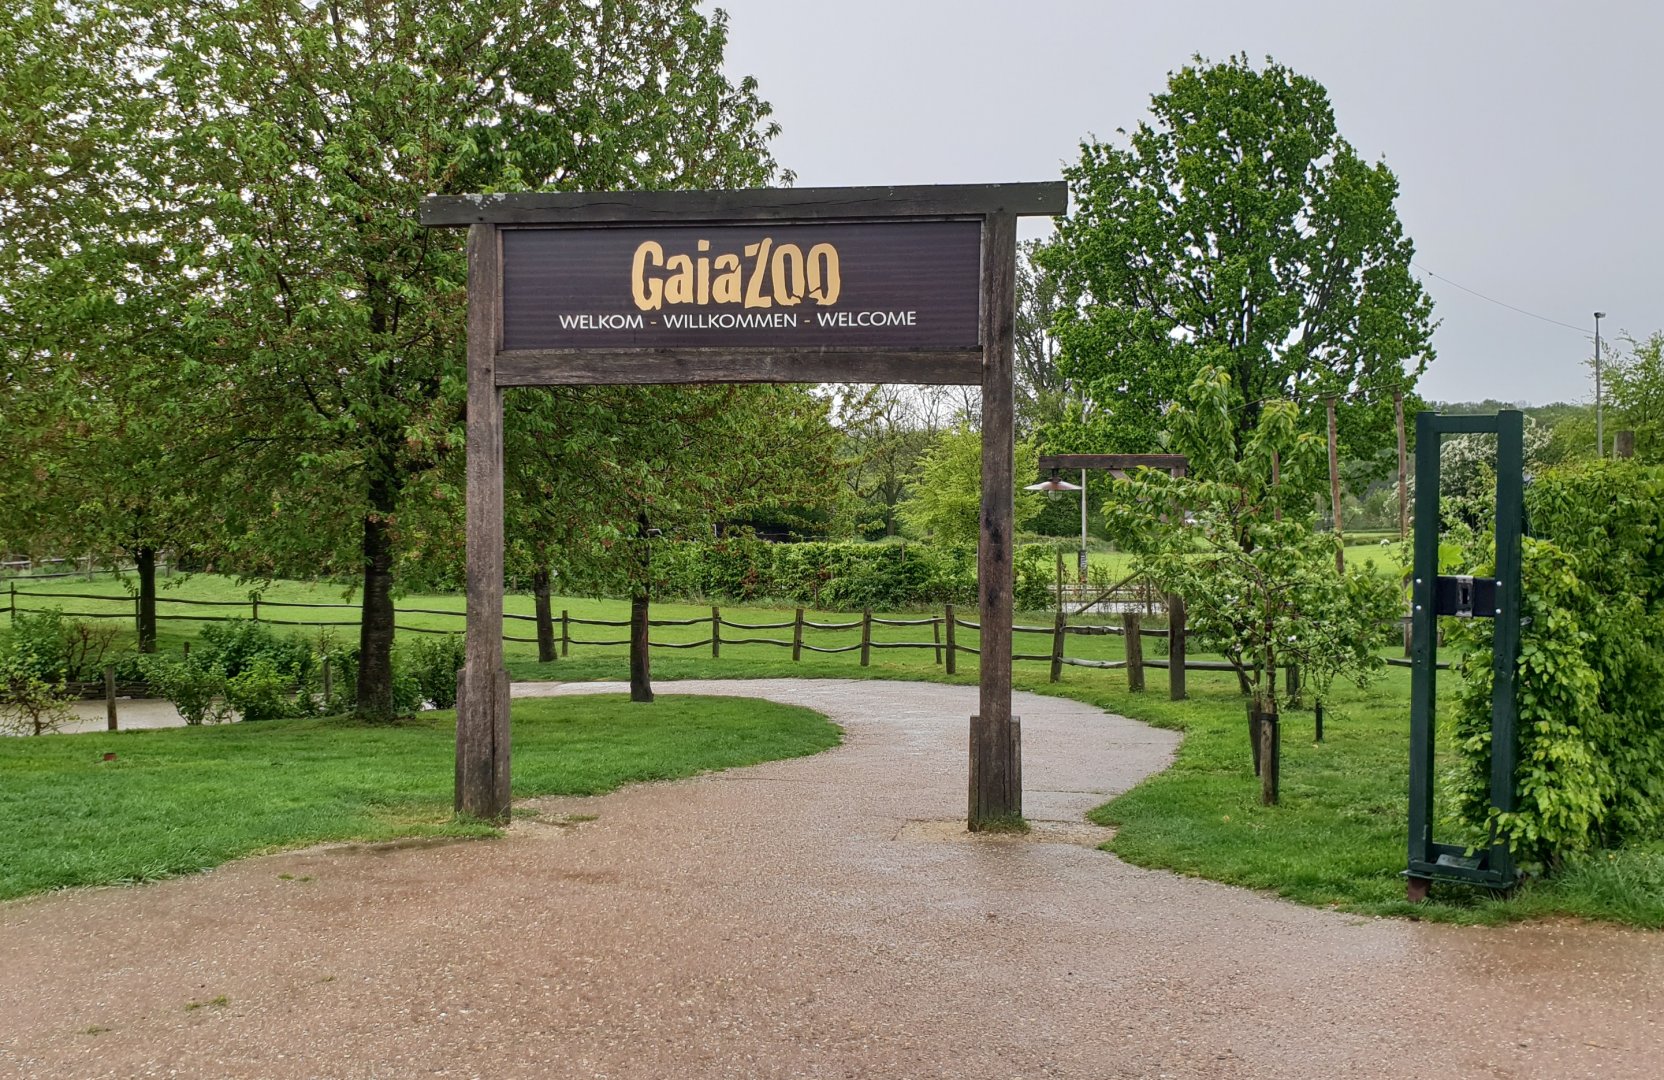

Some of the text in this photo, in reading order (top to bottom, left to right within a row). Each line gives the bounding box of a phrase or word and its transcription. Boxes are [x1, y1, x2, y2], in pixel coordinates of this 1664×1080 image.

[558, 314, 644, 330] WELKOM
[663, 313, 797, 329] WILLKOMMEN
[816, 311, 917, 327] WELCOME
